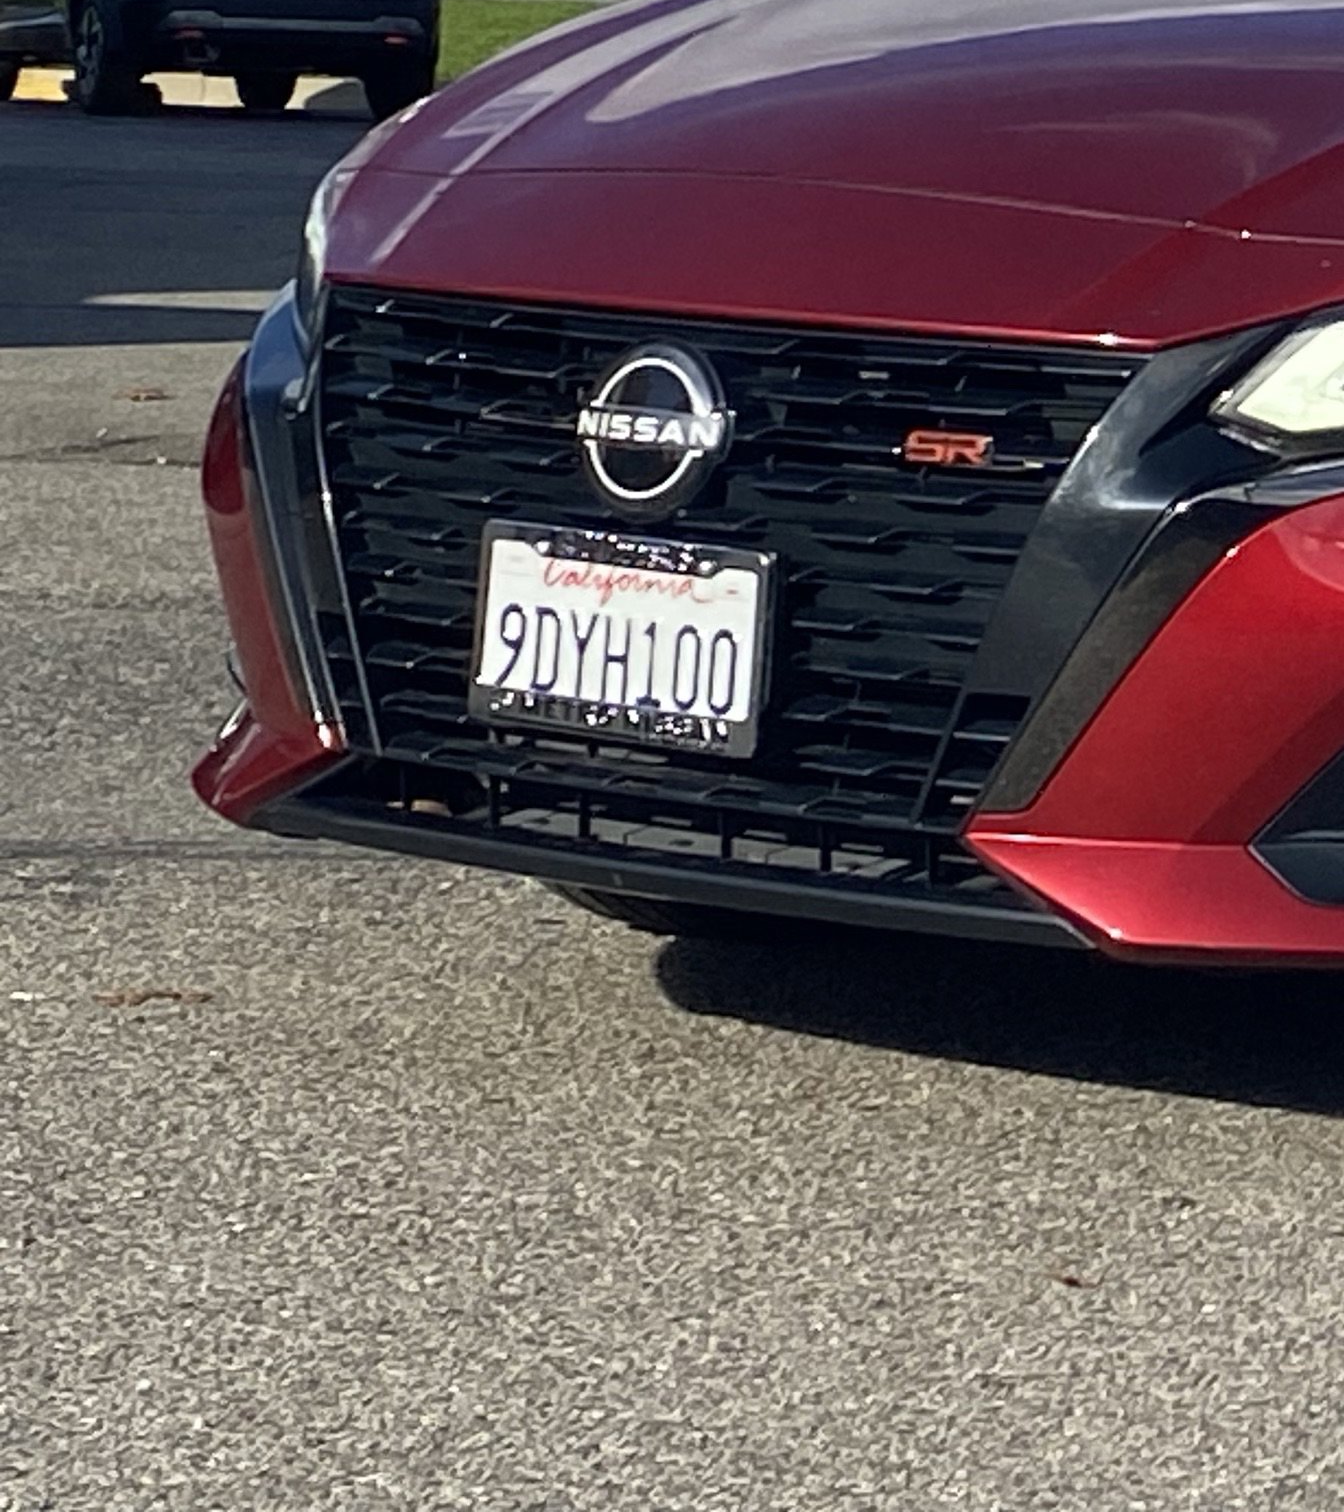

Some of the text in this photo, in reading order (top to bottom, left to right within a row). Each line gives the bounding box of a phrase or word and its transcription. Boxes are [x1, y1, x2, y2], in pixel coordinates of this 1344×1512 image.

[577, 408, 722, 449] NISSAN
[904, 429, 995, 466] SR
[543, 559, 712, 607] California
[496, 602, 738, 716] 9DYH100
